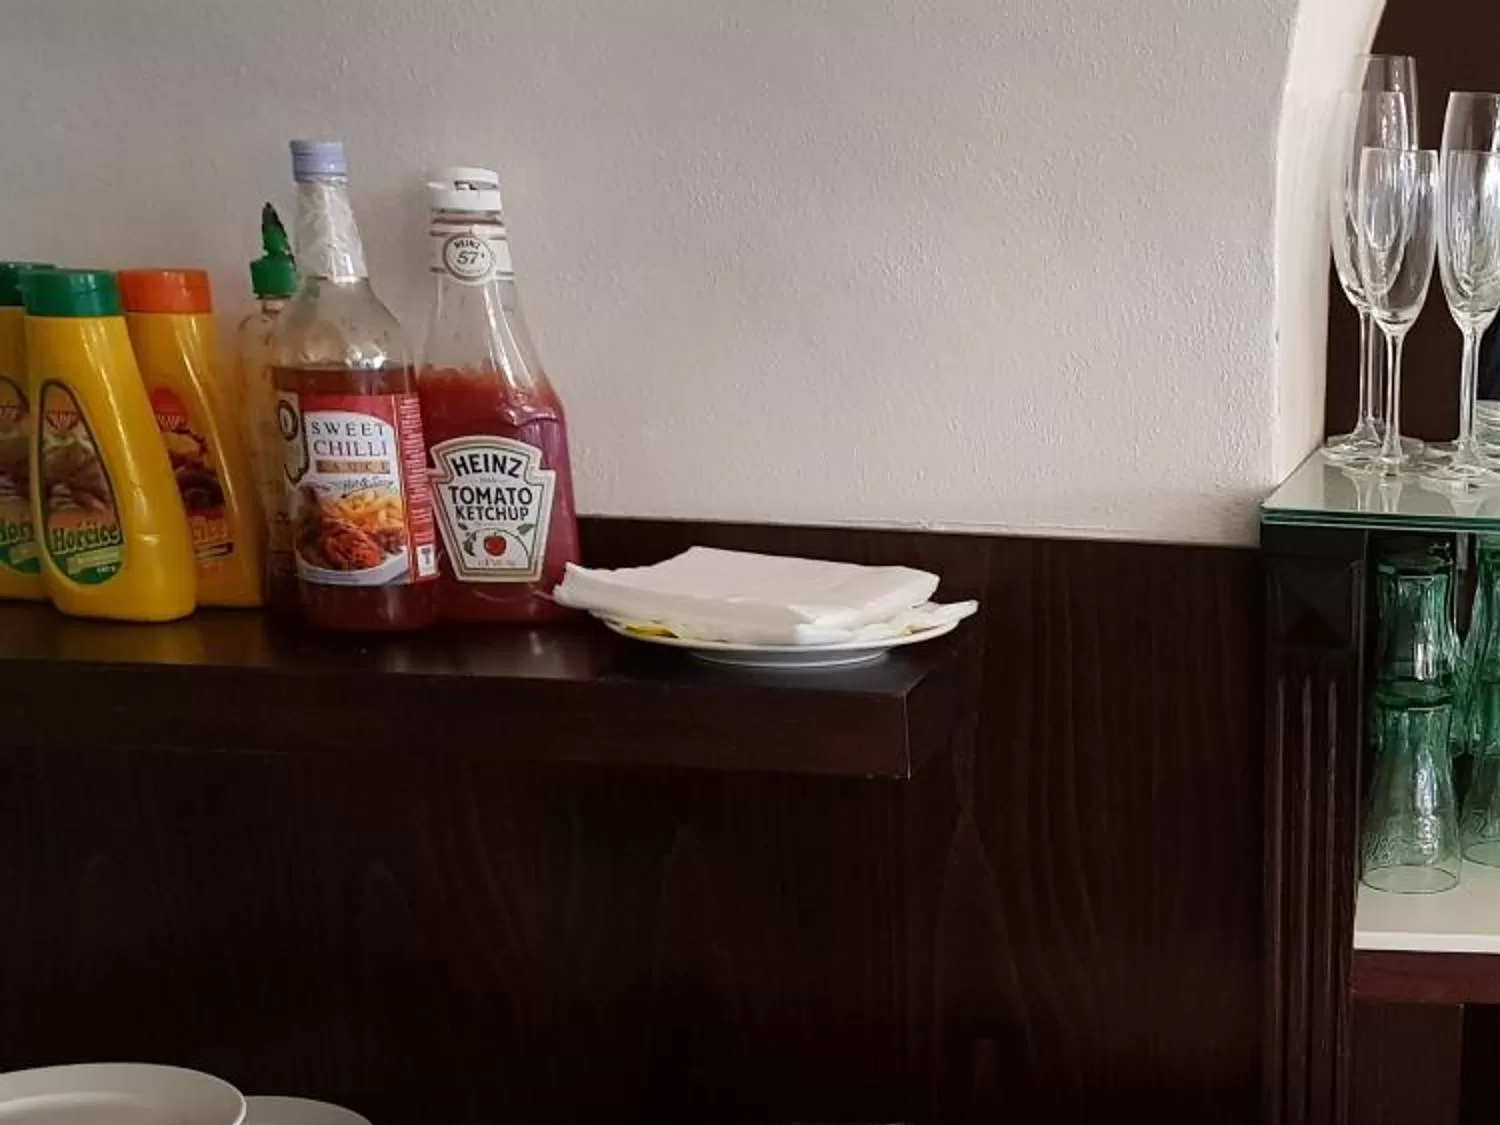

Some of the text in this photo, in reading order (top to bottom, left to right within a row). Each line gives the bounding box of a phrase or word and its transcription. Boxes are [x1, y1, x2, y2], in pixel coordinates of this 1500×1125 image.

[456, 250, 479, 265] 57
[310, 420, 384, 437] SWEET
[312, 439, 388, 458] CHILLI
[450, 453, 523, 479] HEINZ
[447, 485, 534, 506] TOMATO
[455, 505, 530, 521] KETCHUP
